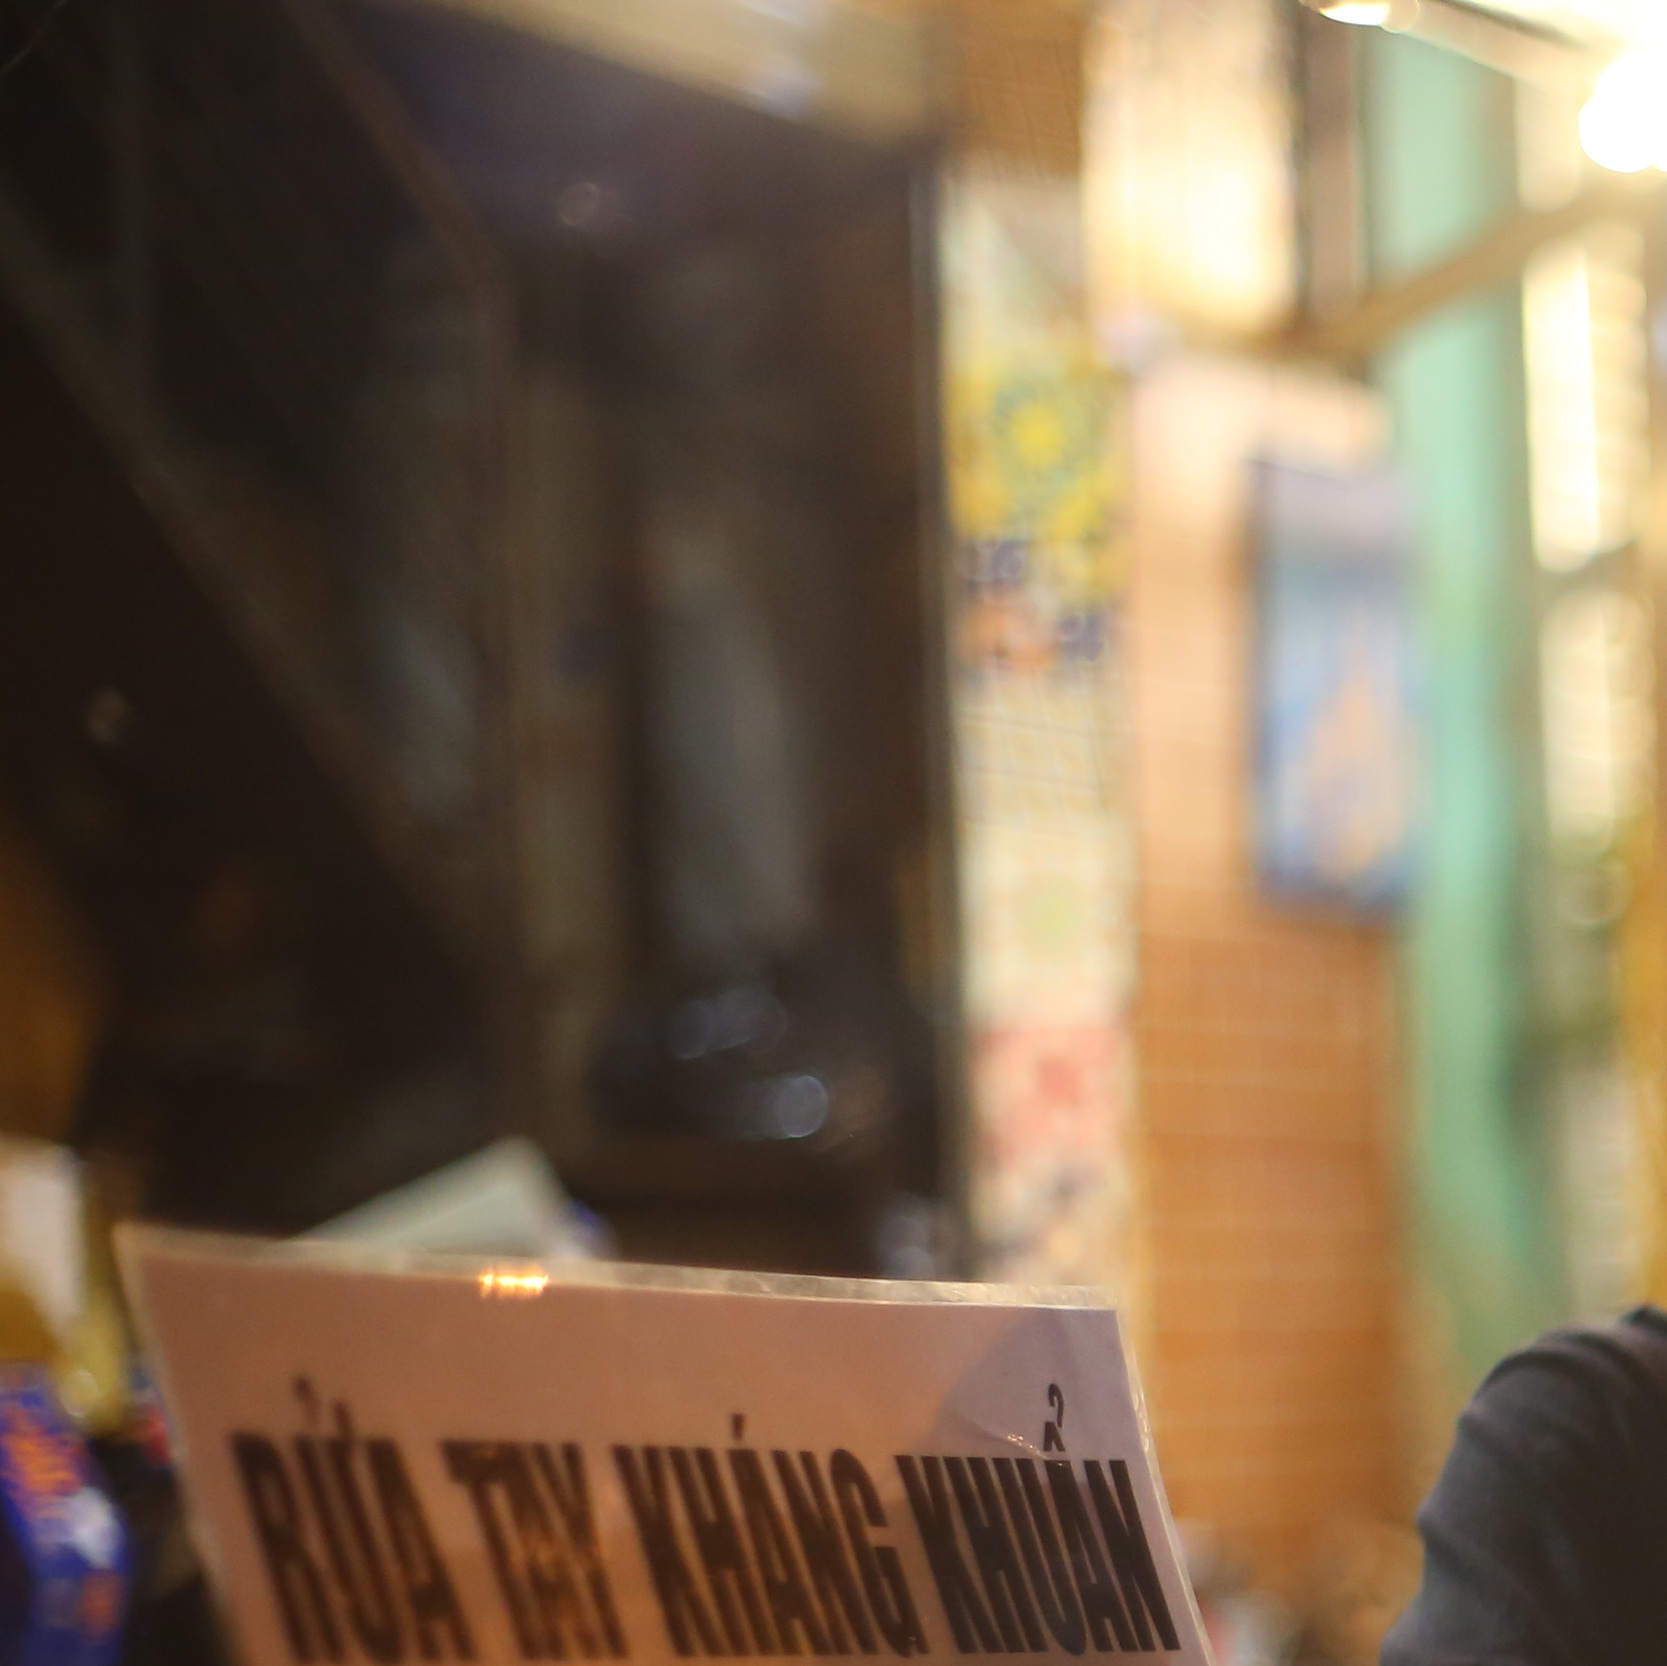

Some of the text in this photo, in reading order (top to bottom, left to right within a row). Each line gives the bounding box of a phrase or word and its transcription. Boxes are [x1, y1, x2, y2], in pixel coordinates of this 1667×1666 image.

[440, 1438, 629, 1662] TAY
[610, 1412, 930, 1661] KHÁNG
[894, 1382, 1181, 1658] KHUẨN
